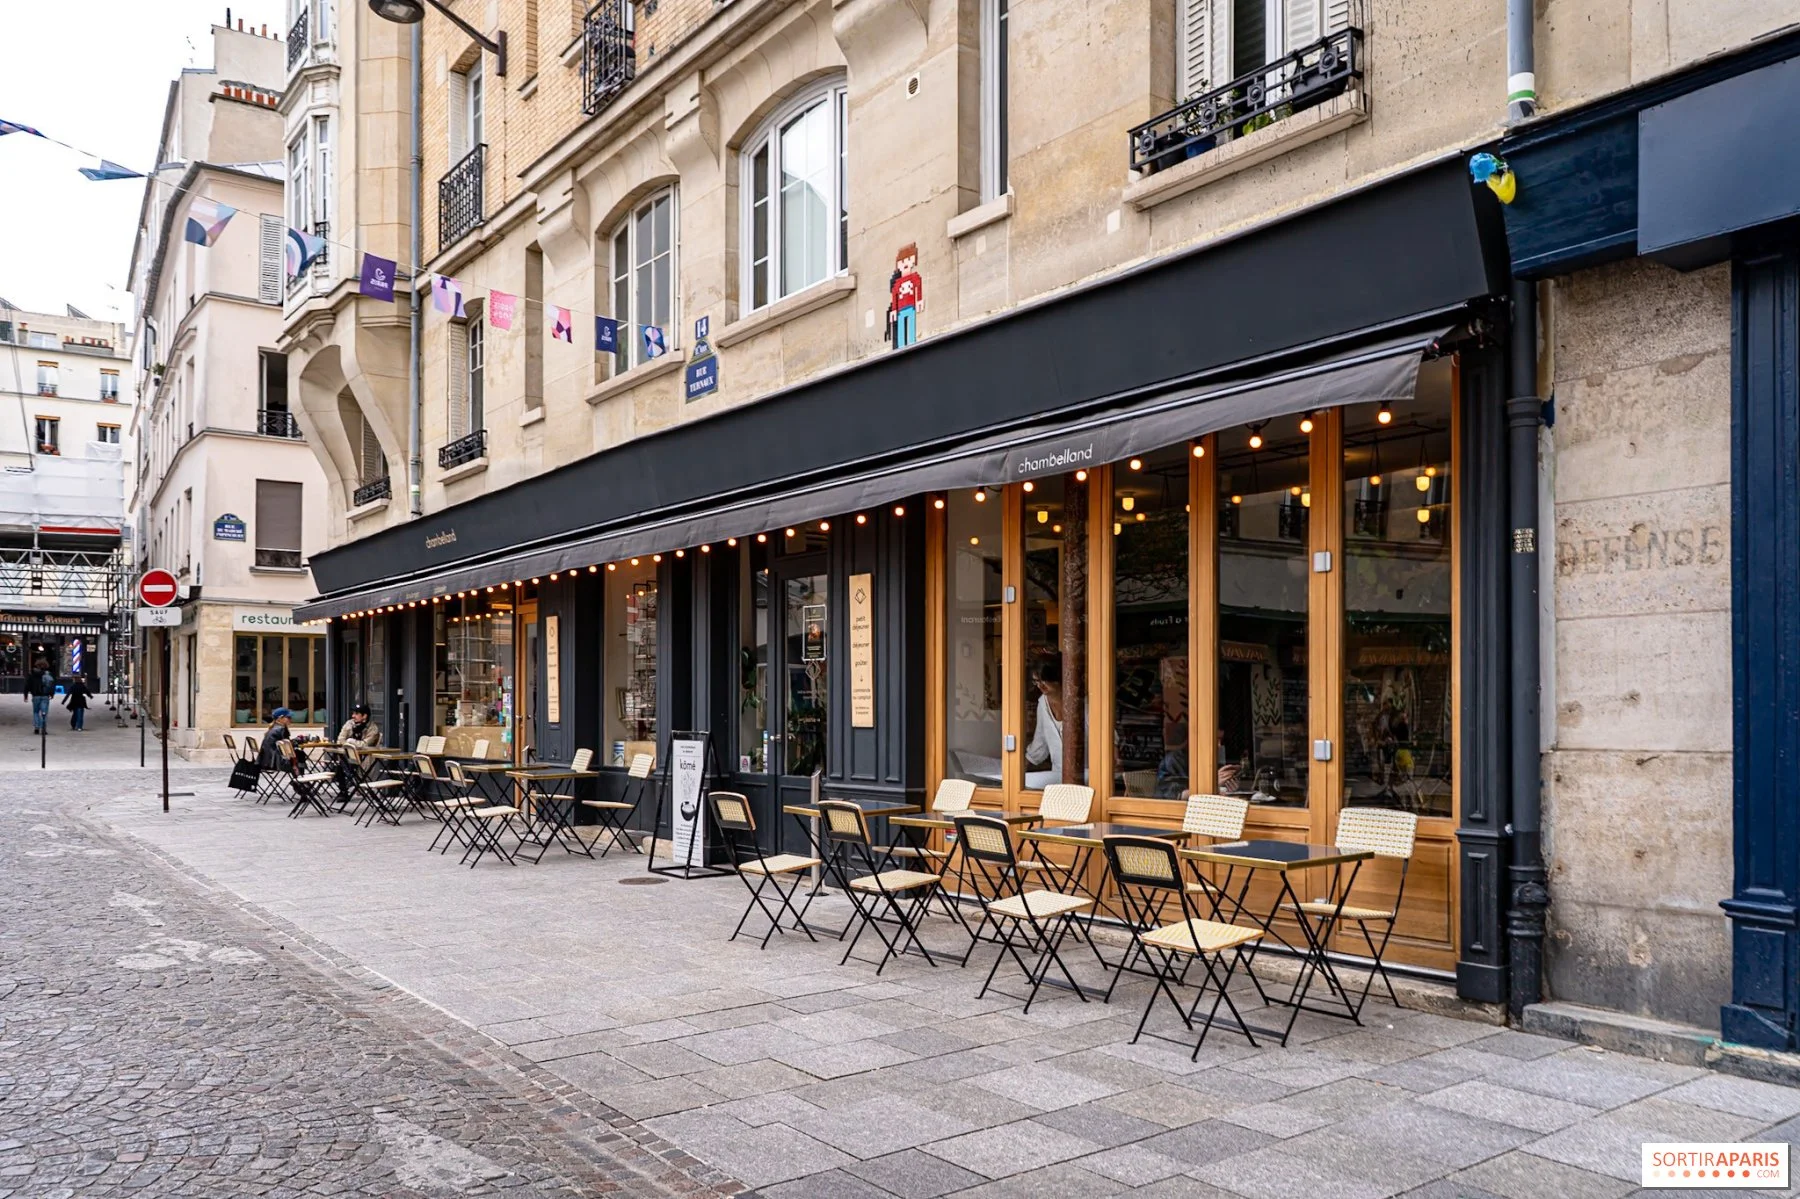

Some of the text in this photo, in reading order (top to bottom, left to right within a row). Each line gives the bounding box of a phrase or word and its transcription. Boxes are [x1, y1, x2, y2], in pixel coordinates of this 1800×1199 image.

[697, 319, 707, 338] 14
[696, 366, 707, 378] RUE
[1018, 443, 1093, 473] chambelland
[425, 528, 457, 549] chambelland
